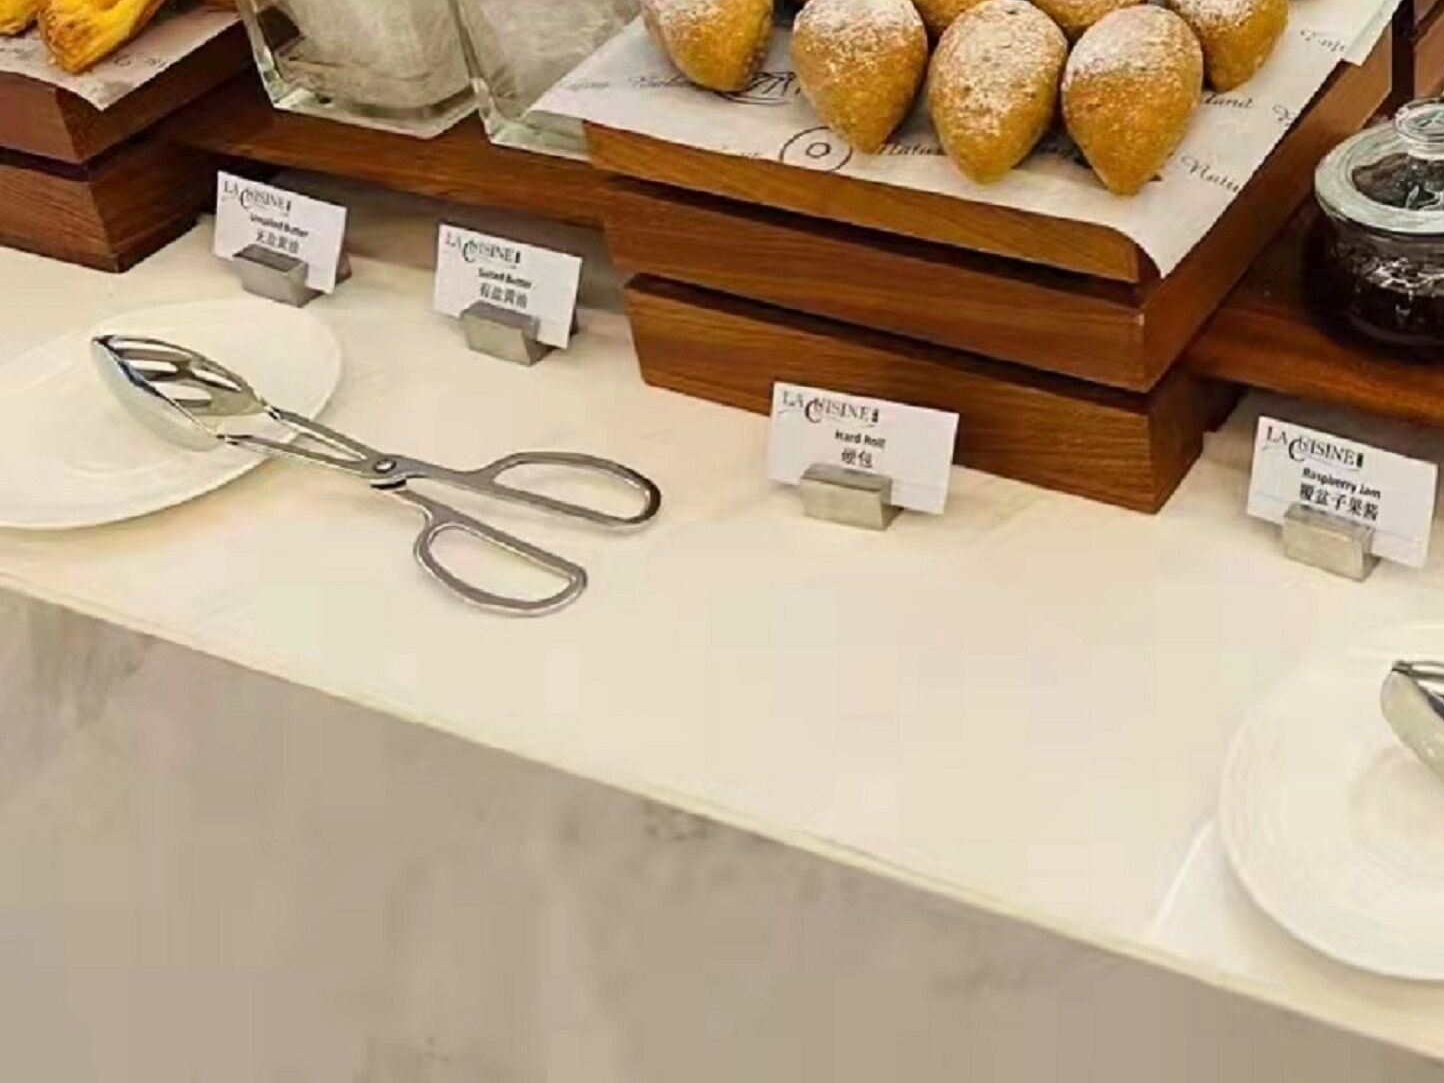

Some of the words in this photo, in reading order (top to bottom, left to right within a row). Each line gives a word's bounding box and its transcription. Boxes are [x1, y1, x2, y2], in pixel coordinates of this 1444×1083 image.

[782, 389, 804, 409] LA
[1266, 425, 1288, 446] LA
[1288, 436, 1355, 468] CUISINE
[1302, 466, 1357, 494] Raspberry
[1358, 483, 1382, 499] Jam
